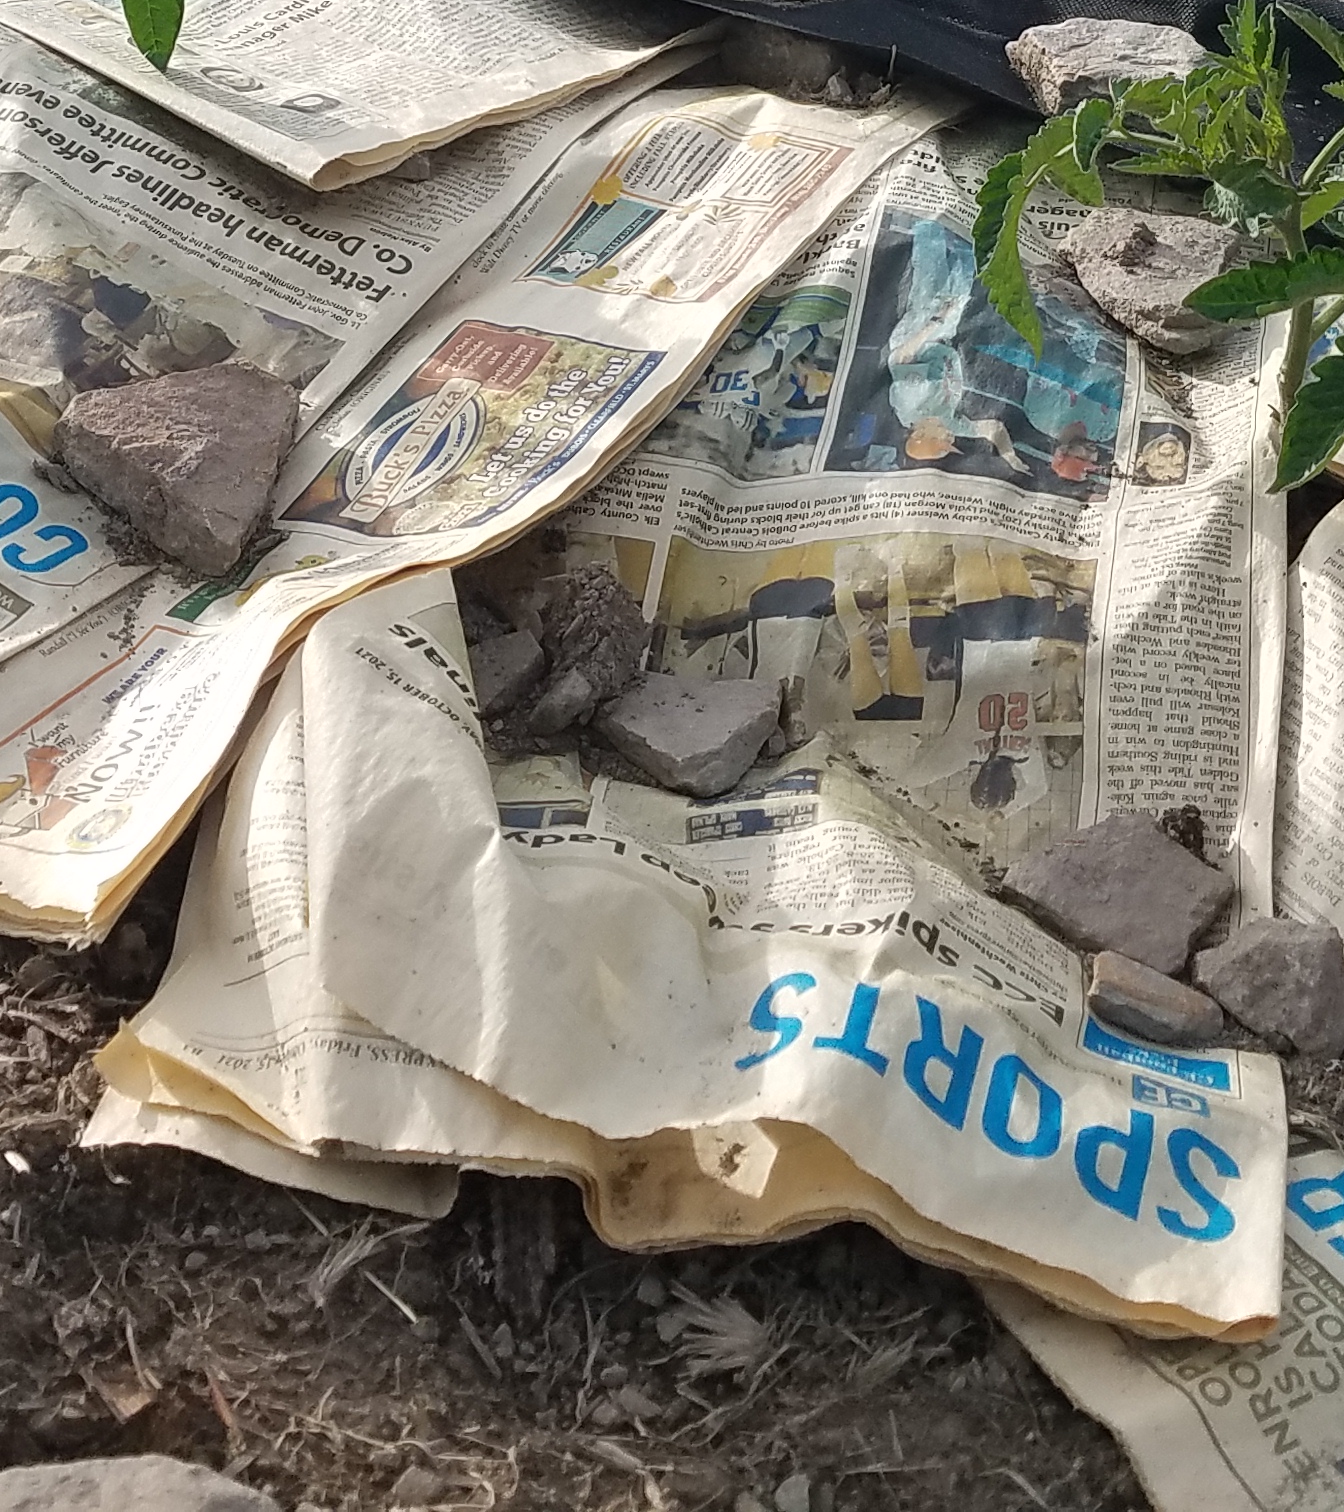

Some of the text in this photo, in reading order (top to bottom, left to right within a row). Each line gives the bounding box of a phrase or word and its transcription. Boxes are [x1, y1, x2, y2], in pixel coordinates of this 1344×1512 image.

[60, 103, 207, 183] Committee
[110, 162, 244, 237] headlines
[139, 217, 168, 239] during
[509, 221, 522, 234] TV
[129, 202, 305, 298] Committee on Tuesday at the Punxsutawney
[167, 235, 206, 260] audience
[369, 242, 414, 278] Co.
[205, 257, 221, 268] the
[244, 223, 392, 306] Fetterman
[221, 263, 263, 289] addresses
[262, 284, 307, 310] Fetterman
[468, 364, 588, 491] Let us do the
[484, 351, 631, 501] Cooking for You!
[351, 432, 423, 524] Buck's
[600, 507, 659, 525] Elk County
[616, 500, 661, 512] over the
[832, 509, 860, 523] spike
[868, 509, 889, 519] hits
[721, 521, 761, 532] Central
[799, 512, 831, 526] before
[102, 646, 167, 705] WE ARE YOUR
[354, 646, 460, 722] OCTOBER 15, 2021
[40, 721, 68, 746] want
[1108, 721, 1193, 734] game home.
[57, 728, 108, 771] Furniture
[1107, 749, 1157, 761] Southern
[1139, 765, 1161, 775] this
[1167, 766, 1193, 778] Tide
[1199, 768, 1238, 780] Golden
[789, 909, 1066, 1026] ECC spikers
[1018, 968, 1049, 992] Chris
[309, 1037, 360, 1056] Friday,
[737, 976, 1237, 1239] SPORTS
[1275, 1301, 1342, 1396] CAL
[1271, 1363, 1313, 1413] IS
